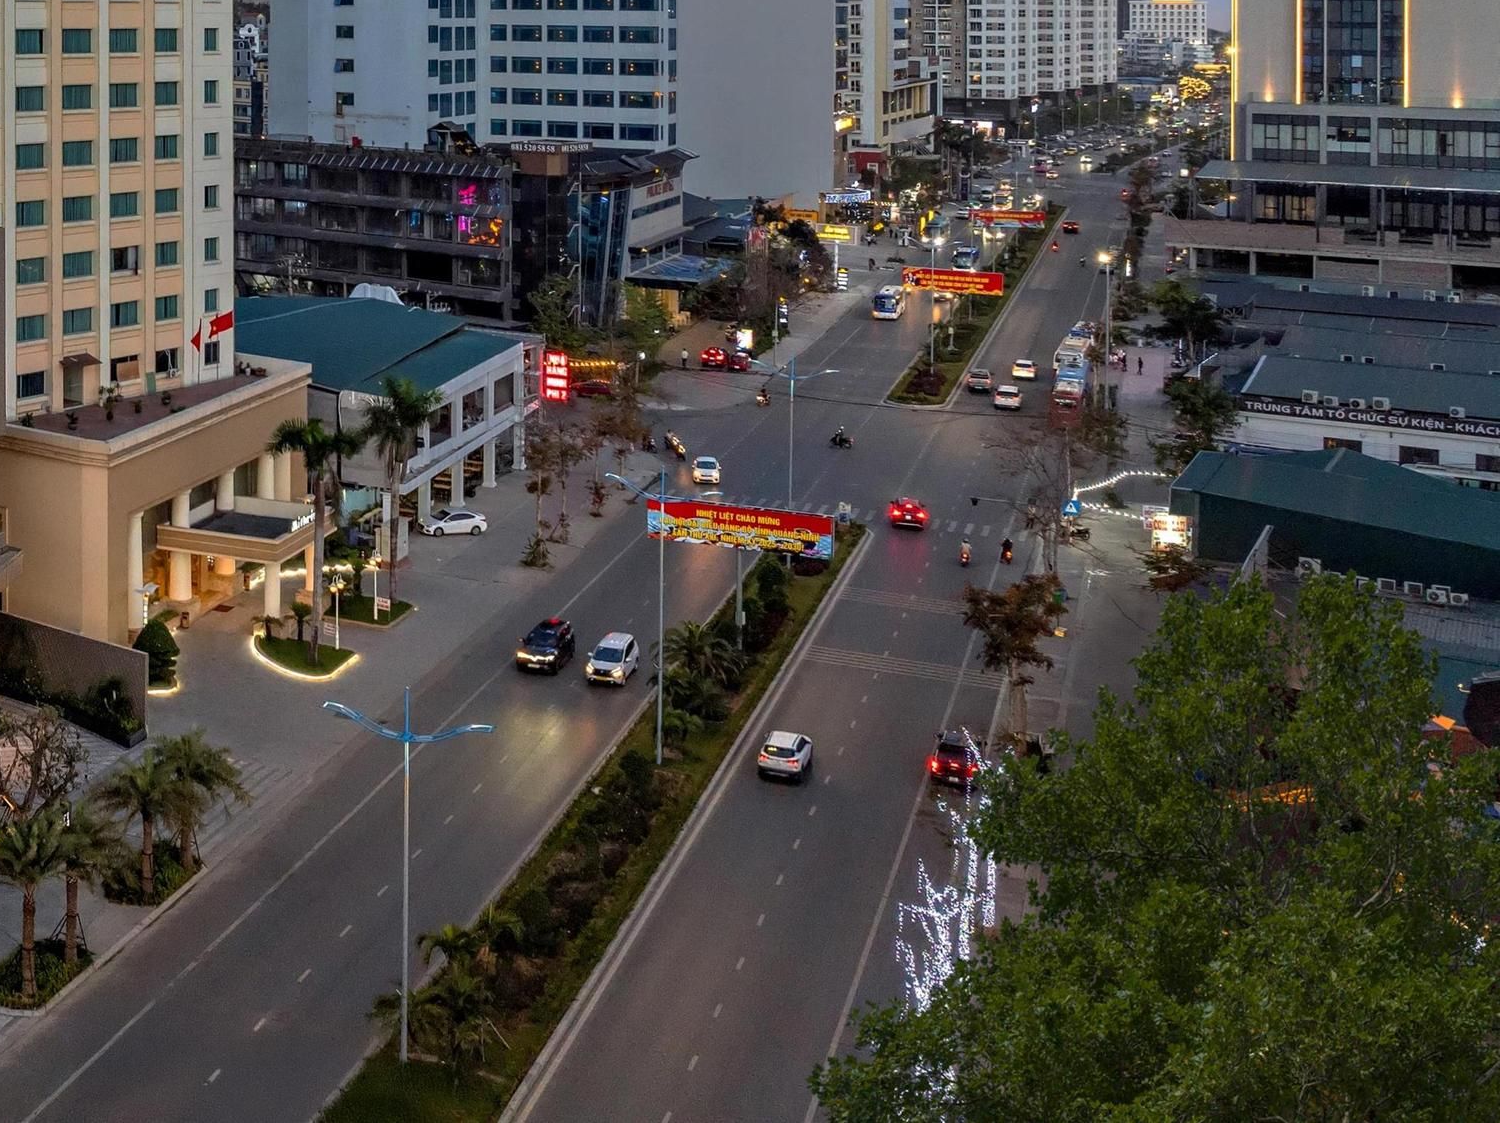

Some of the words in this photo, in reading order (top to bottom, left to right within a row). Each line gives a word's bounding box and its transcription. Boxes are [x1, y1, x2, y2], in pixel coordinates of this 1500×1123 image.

[1245, 401, 1290, 413] TRUNG
[1293, 406, 1323, 417] TÂM
[1349, 412, 1385, 423] CHỨC
[1388, 416, 1409, 427] SỰ
[1411, 418, 1444, 430] KIỆN
